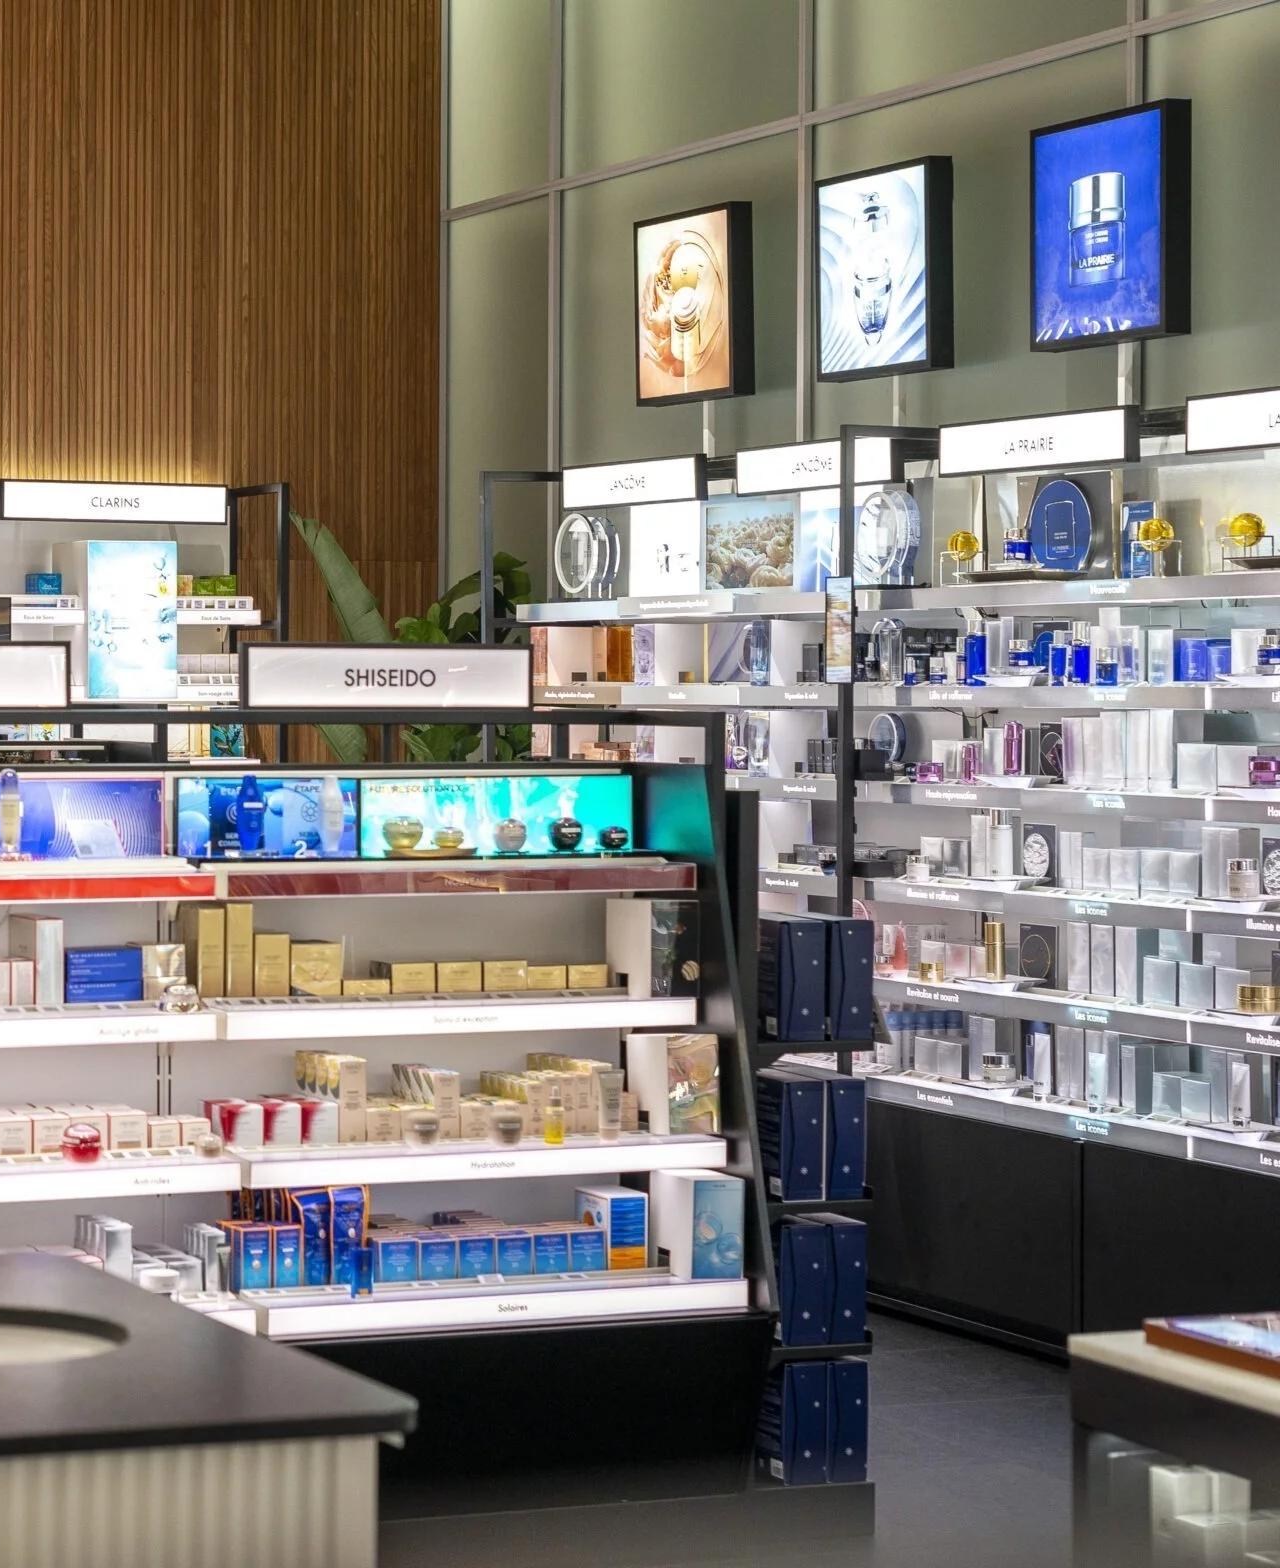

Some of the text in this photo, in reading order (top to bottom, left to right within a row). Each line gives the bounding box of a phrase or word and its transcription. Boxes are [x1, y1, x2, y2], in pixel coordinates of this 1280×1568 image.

[1079, 253, 1115, 269] LA PRAIRIE
[1004, 436, 1055, 455] LA PRAIRIE
[89, 496, 141, 510] CLARINS
[343, 668, 437, 688] SHISEIDO
[294, 784, 321, 793] ÉTAPE
[294, 840, 308, 858] 2
[1245, 918, 1274, 932] Illumine
[933, 991, 939, 1001] et
[1075, 1008, 1086, 1021] Les
[917, 1089, 927, 1101] Les
[1075, 1119, 1087, 1133] Les
[1259, 1153, 1273, 1166] Les
